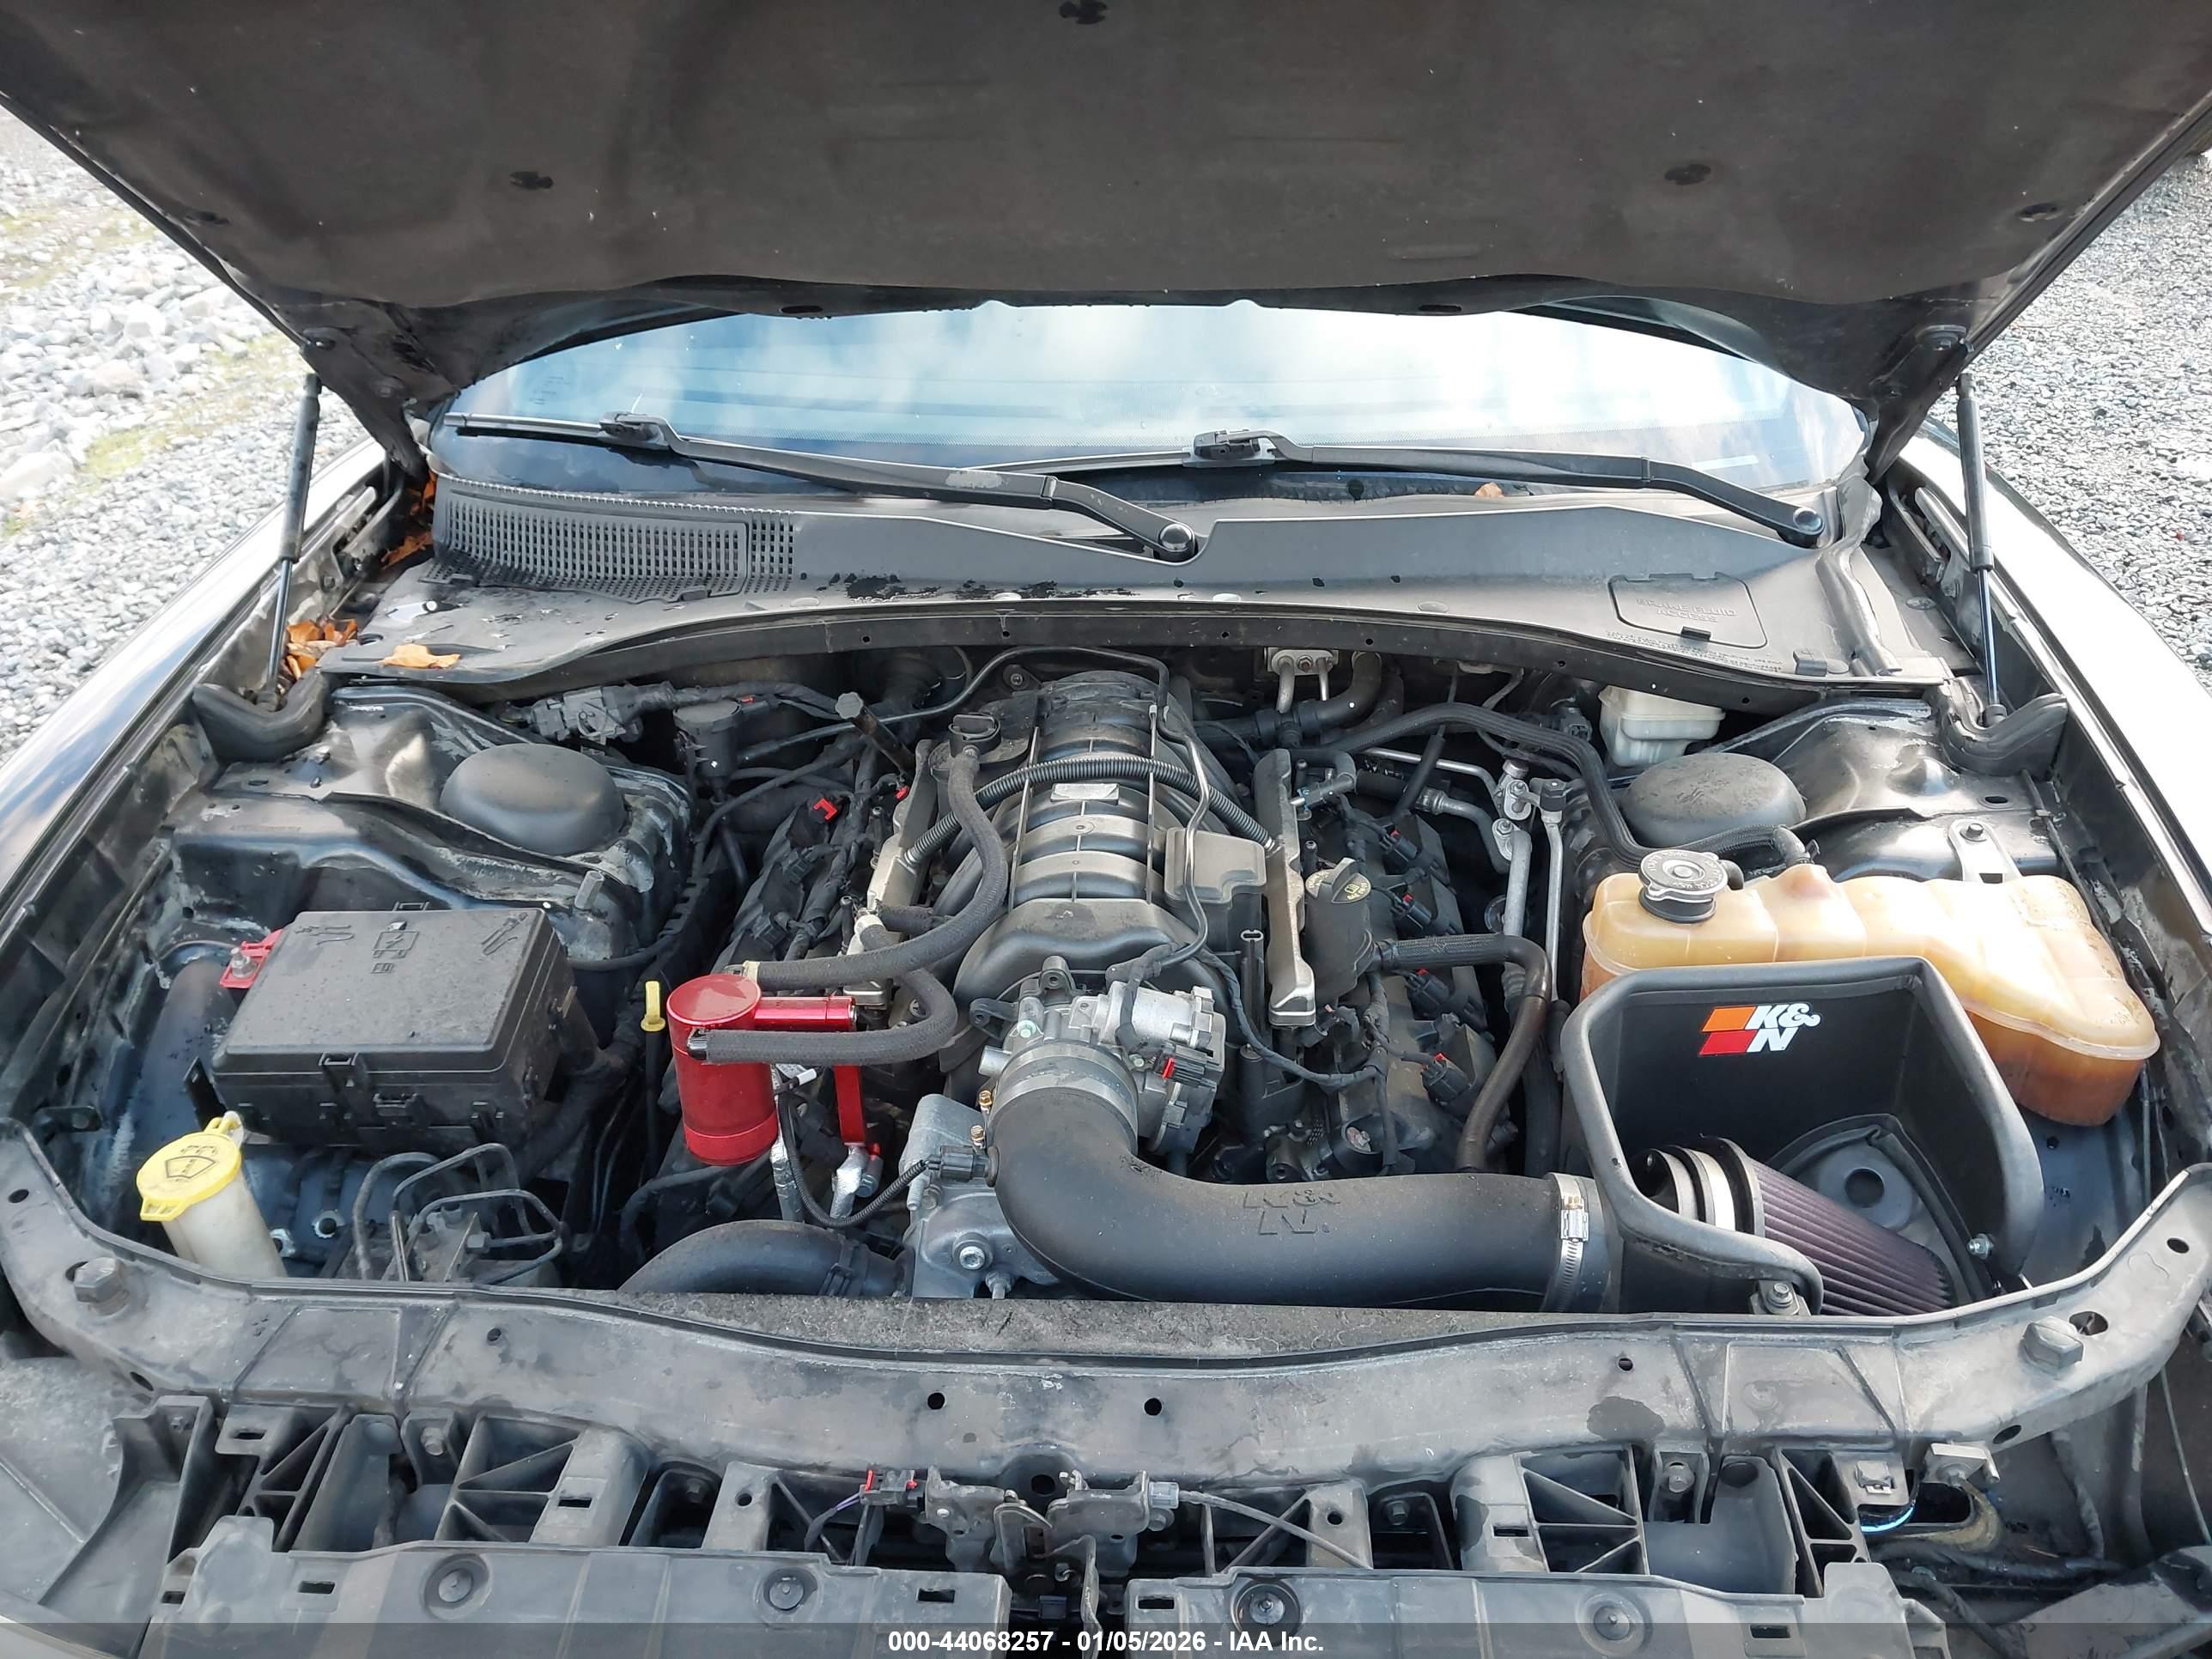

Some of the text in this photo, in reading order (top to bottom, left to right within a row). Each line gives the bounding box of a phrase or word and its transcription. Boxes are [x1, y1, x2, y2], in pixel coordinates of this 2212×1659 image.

[1636, 598, 1738, 617] BRAKE FLUID
[1656, 608, 1718, 623] ACCESS
